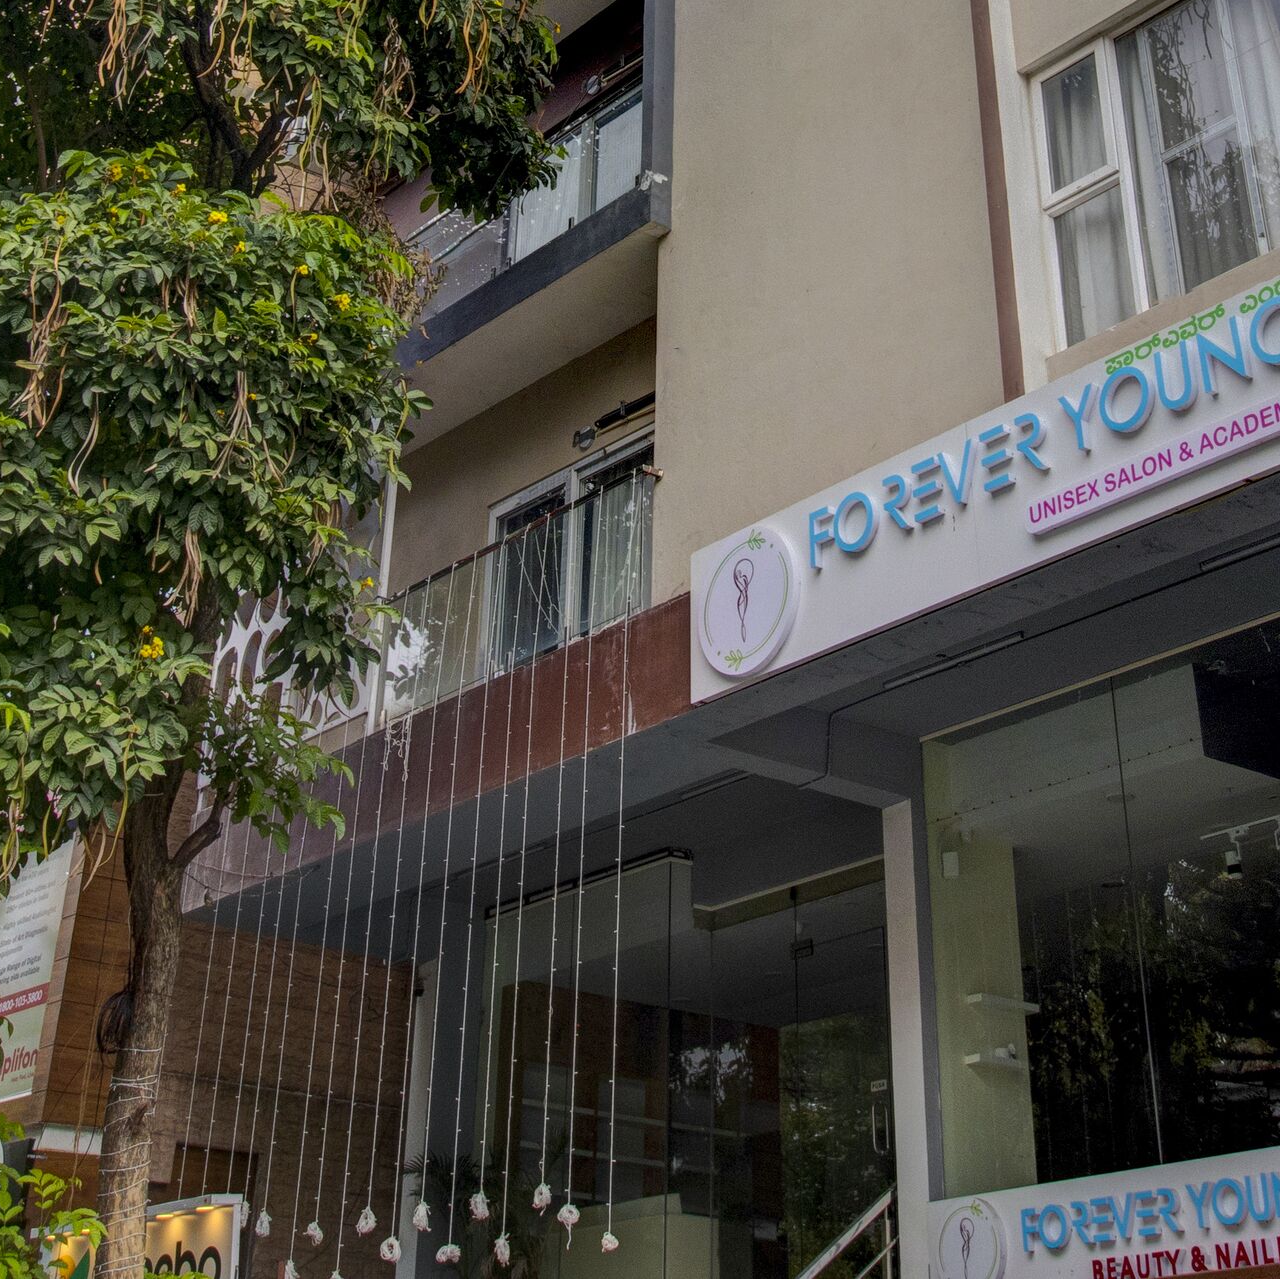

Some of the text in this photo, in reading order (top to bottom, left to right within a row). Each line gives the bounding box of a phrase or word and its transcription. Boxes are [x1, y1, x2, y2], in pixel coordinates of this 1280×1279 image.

[808, 412, 1052, 570] FOREVER
[1028, 480, 1101, 526] UNISEX
[1104, 456, 1173, 491] SALON
[1178, 441, 1194, 462] &
[1021, 1186, 1181, 1253] FOREVER
[1092, 1247, 1179, 1279] BEAUTY
[1191, 1246, 1205, 1272] &
